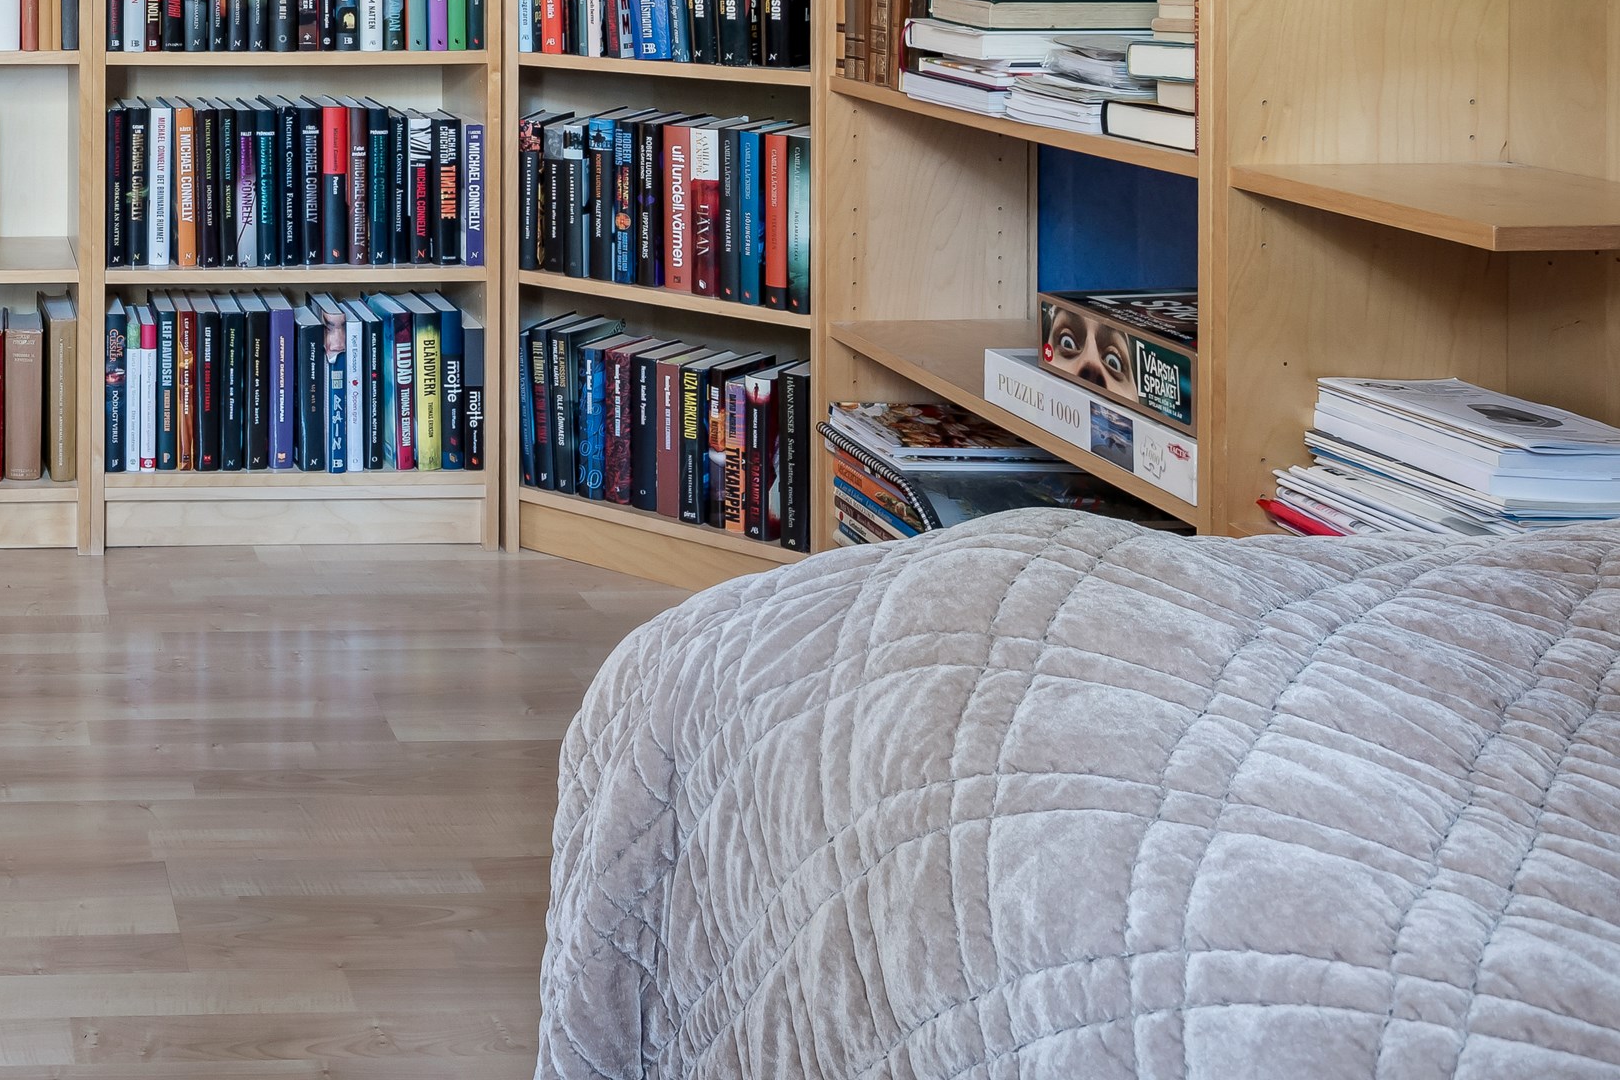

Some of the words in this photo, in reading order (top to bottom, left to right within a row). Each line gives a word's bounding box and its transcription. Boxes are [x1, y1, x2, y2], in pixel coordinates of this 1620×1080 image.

[148, 3, 159, 23] NOLL
[157, 146, 165, 171] CONNELLY
[181, 134, 192, 174] MICHAEL
[440, 126, 448, 163] CRICHTON
[448, 129, 456, 160] MICHAEL
[672, 146, 684, 162] ulf
[468, 143, 479, 183] MICHAEL
[181, 176, 192, 222] CONNELLY
[441, 166, 456, 219] TIMELINE
[469, 185, 480, 231] CONNELLY
[156, 220, 164, 243] RUMMET
[109, 329, 117, 362] CUSSLER
[116, 335, 124, 357] CLIVE
[162, 321, 171, 339] LEIF
[162, 341, 171, 386] DAVIDSEN
[424, 340, 437, 396] BLÄNDVERK
[1143, 351, 1176, 384] VÄRSTA
[684, 373, 697, 389] LIZA
[787, 376, 795, 403] HÅKAN
[1143, 376, 1177, 398] SPRÅKET
[401, 388, 410, 416] THOMAS
[467, 391, 482, 427] motte
[684, 392, 697, 439] MARKLUND
[998, 373, 1045, 411] PUZZLE
[1050, 398, 1080, 428] 1000
[402, 418, 410, 446] ERIKSON
[557, 412, 565, 445] LÖNNAEUS
[787, 438, 795, 460] Svalan,
[726, 448, 740, 523] TVEKAMPEN
